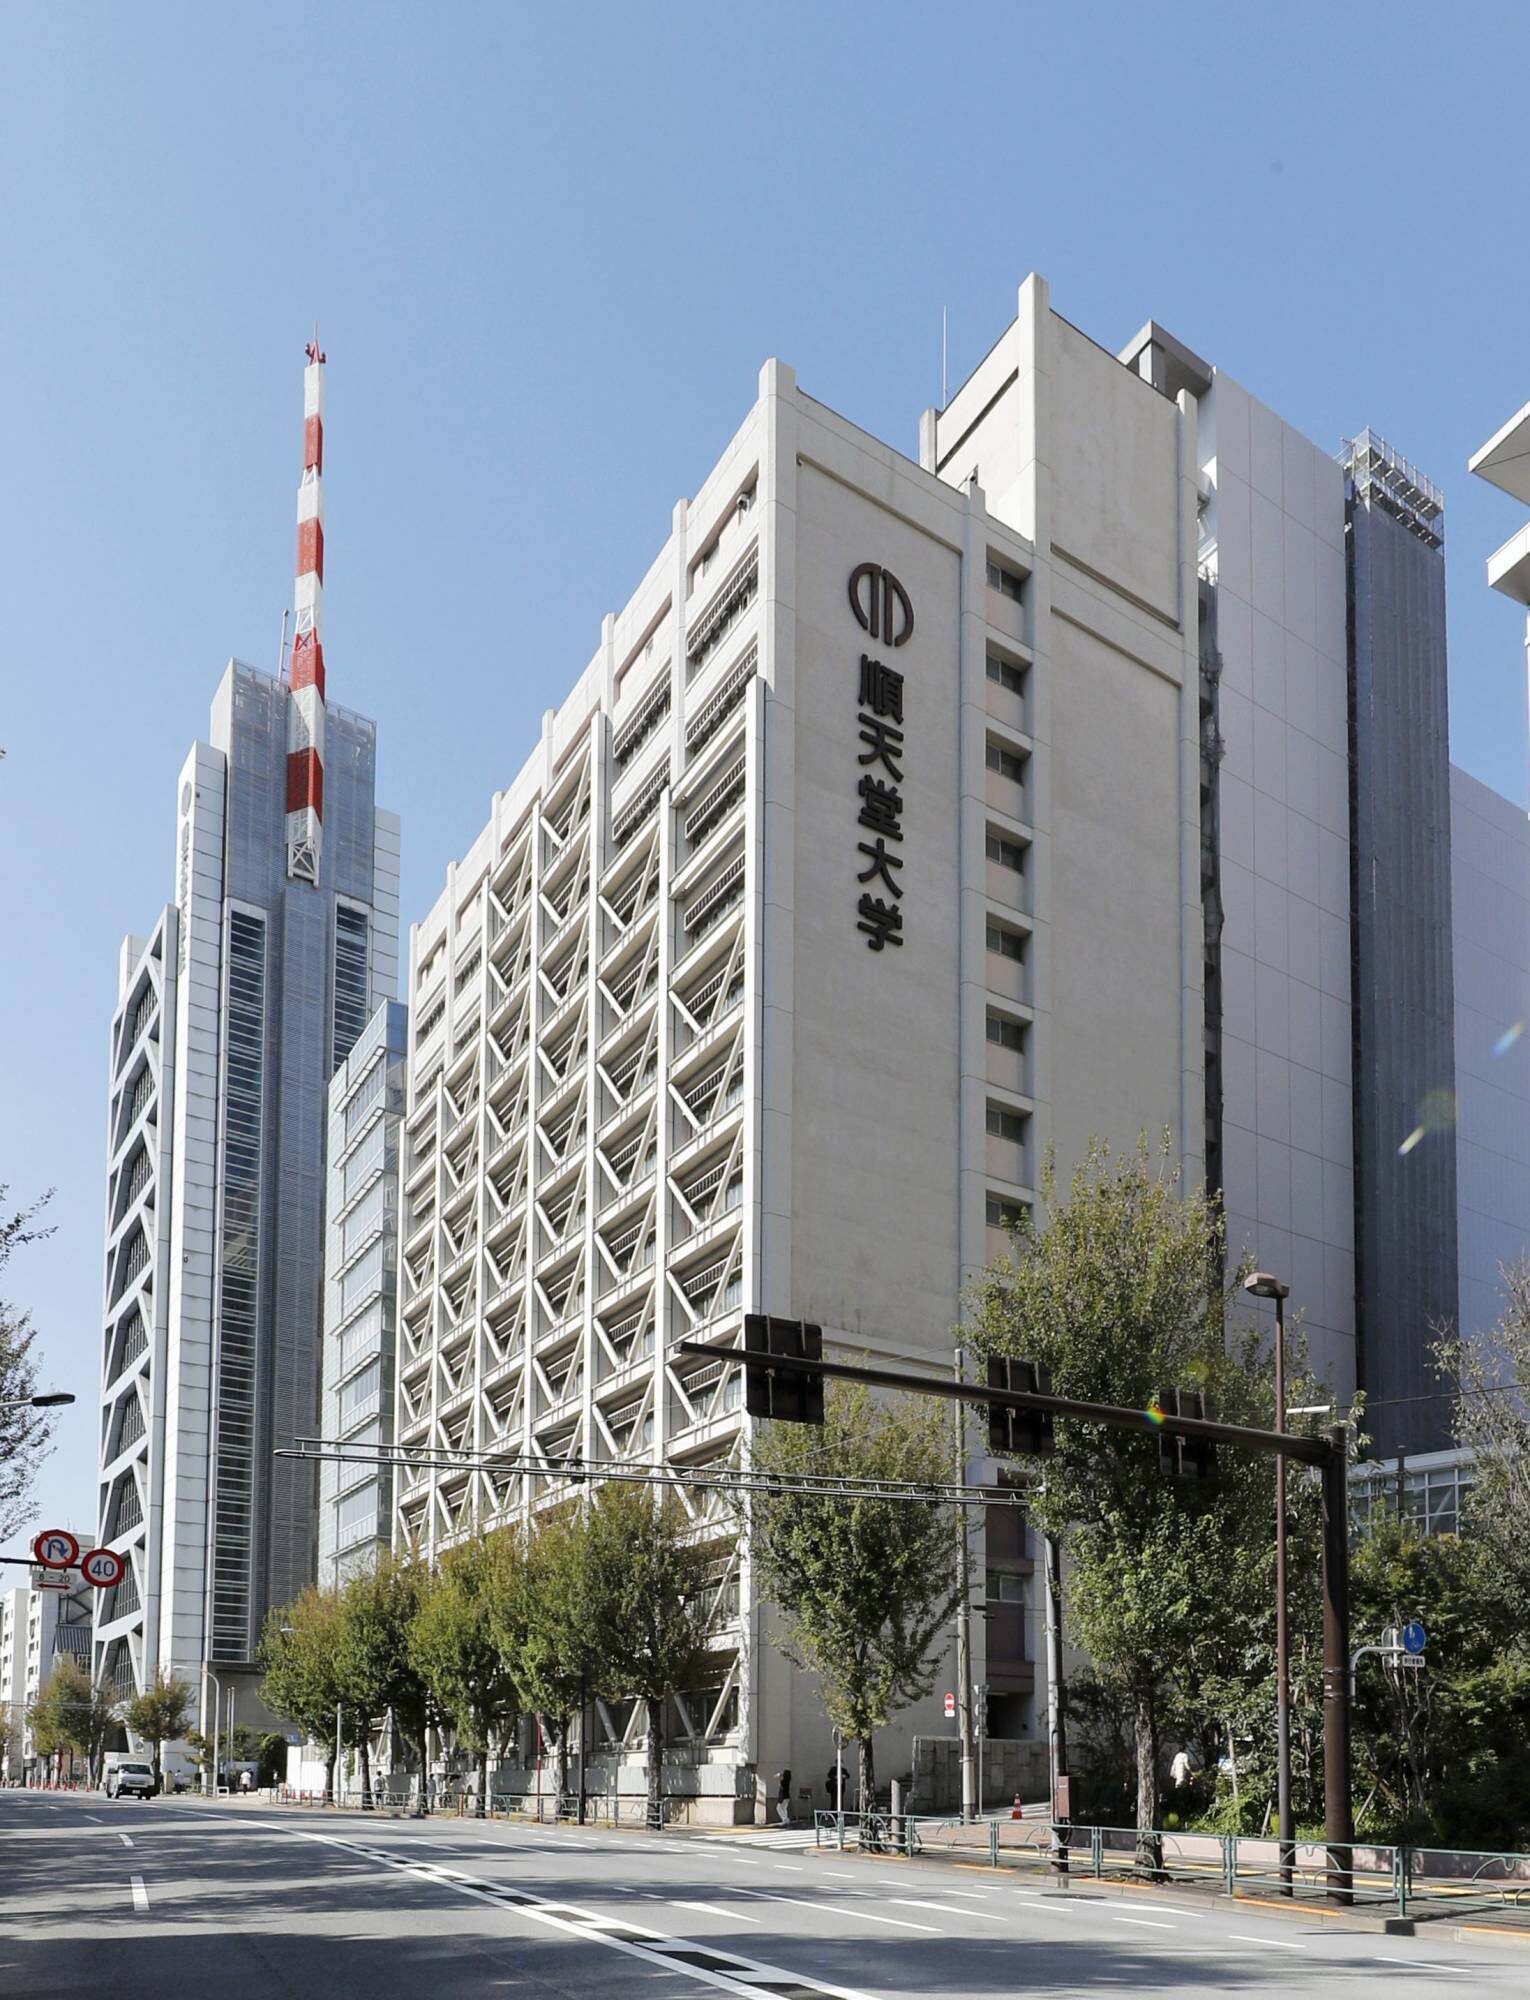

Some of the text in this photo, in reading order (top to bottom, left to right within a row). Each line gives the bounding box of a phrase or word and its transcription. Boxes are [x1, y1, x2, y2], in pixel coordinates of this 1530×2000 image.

[858, 653, 904, 951] 順天堂大学
[92, 1560, 115, 1577] 40
